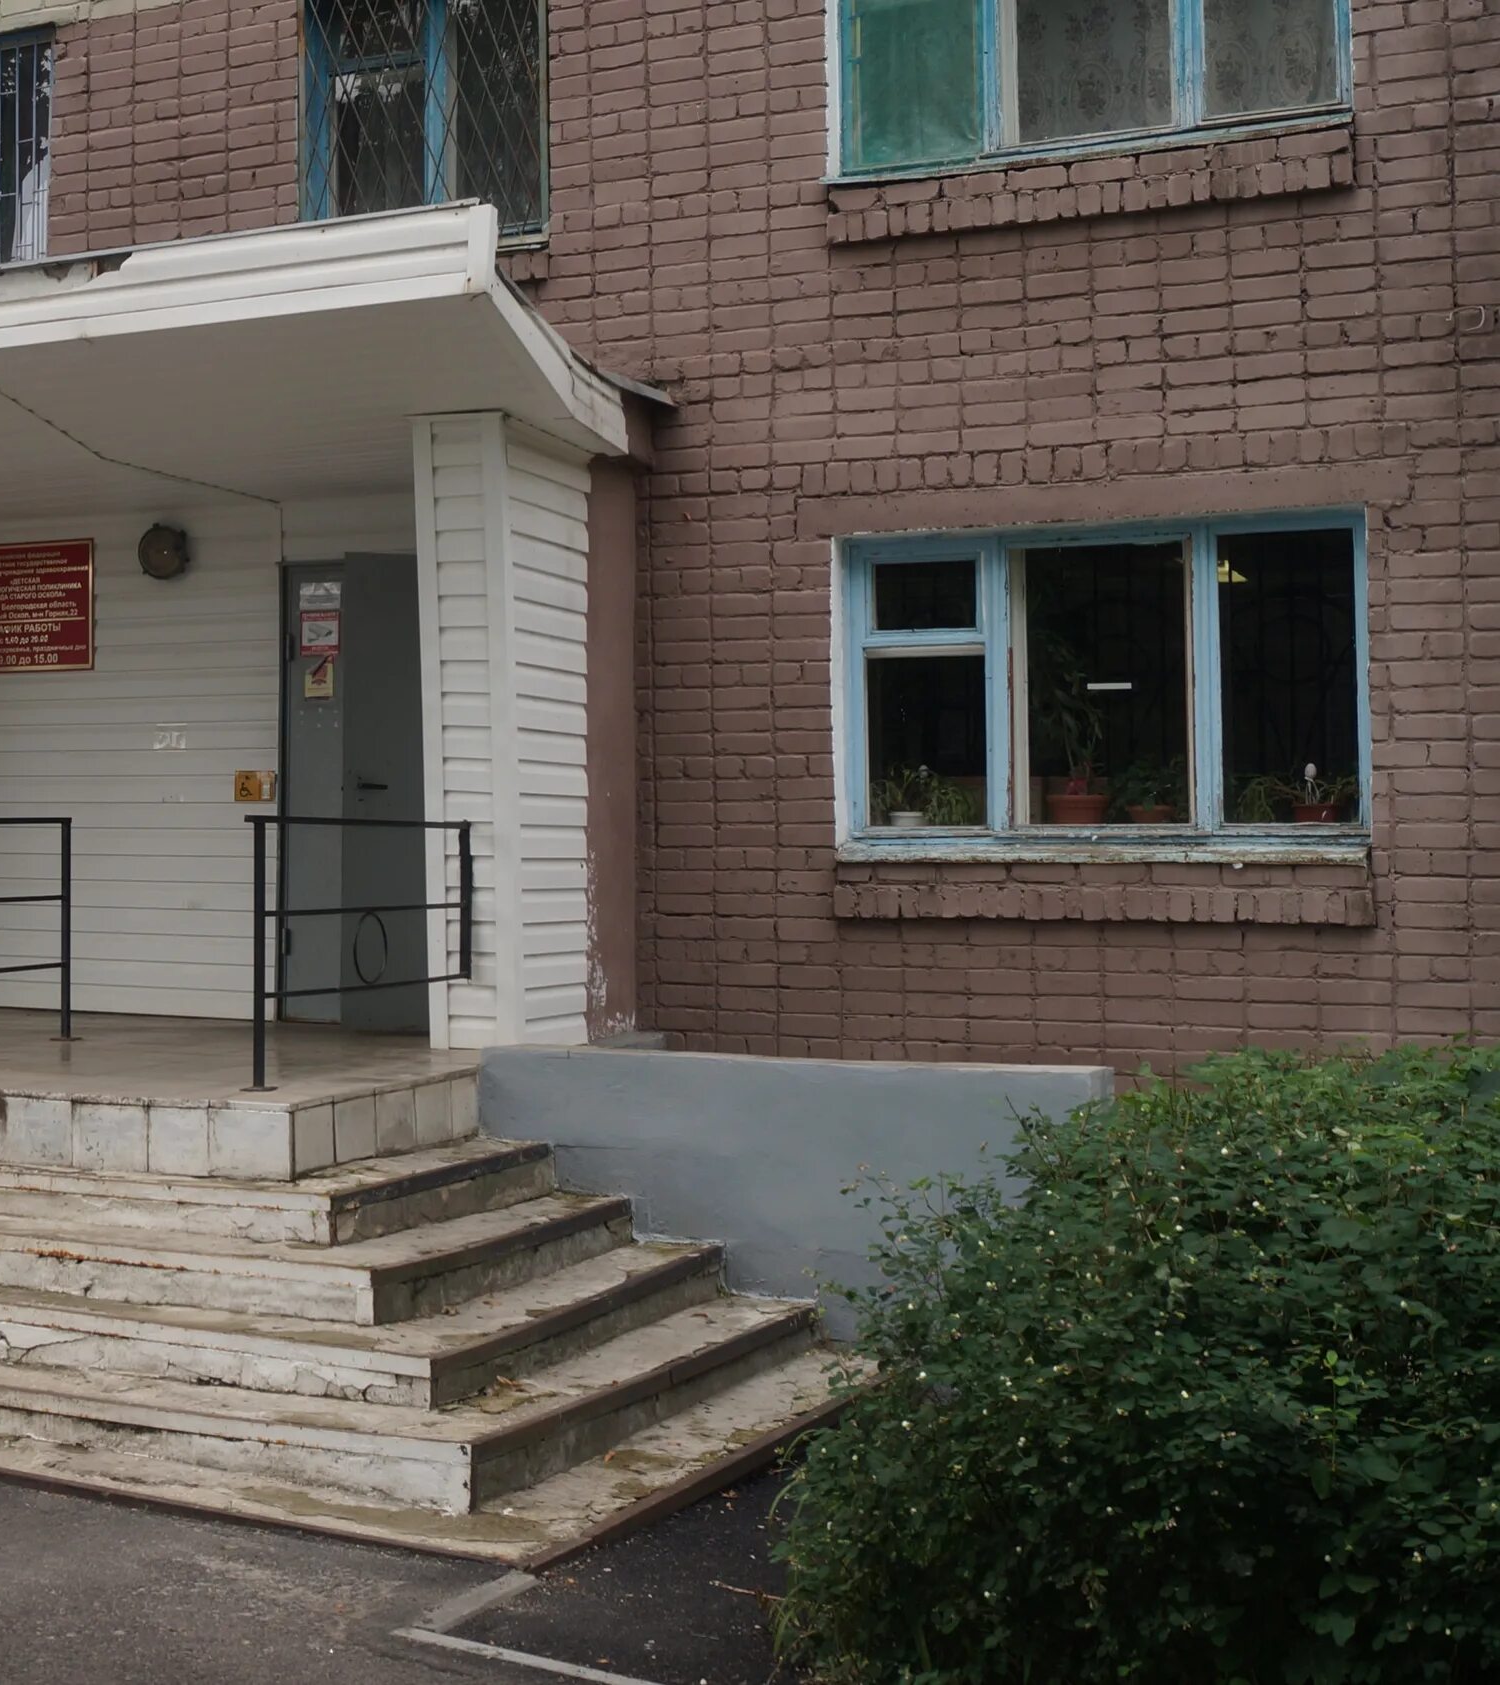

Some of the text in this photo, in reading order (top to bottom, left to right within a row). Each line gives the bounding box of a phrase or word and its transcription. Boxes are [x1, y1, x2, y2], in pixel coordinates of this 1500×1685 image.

[37, 582, 82, 592] ПОЛИКЛИНИКА
[24, 622, 61, 633] РАБОТЫ
[18, 656, 31, 666] до
[33, 653, 59, 664] 15.00
